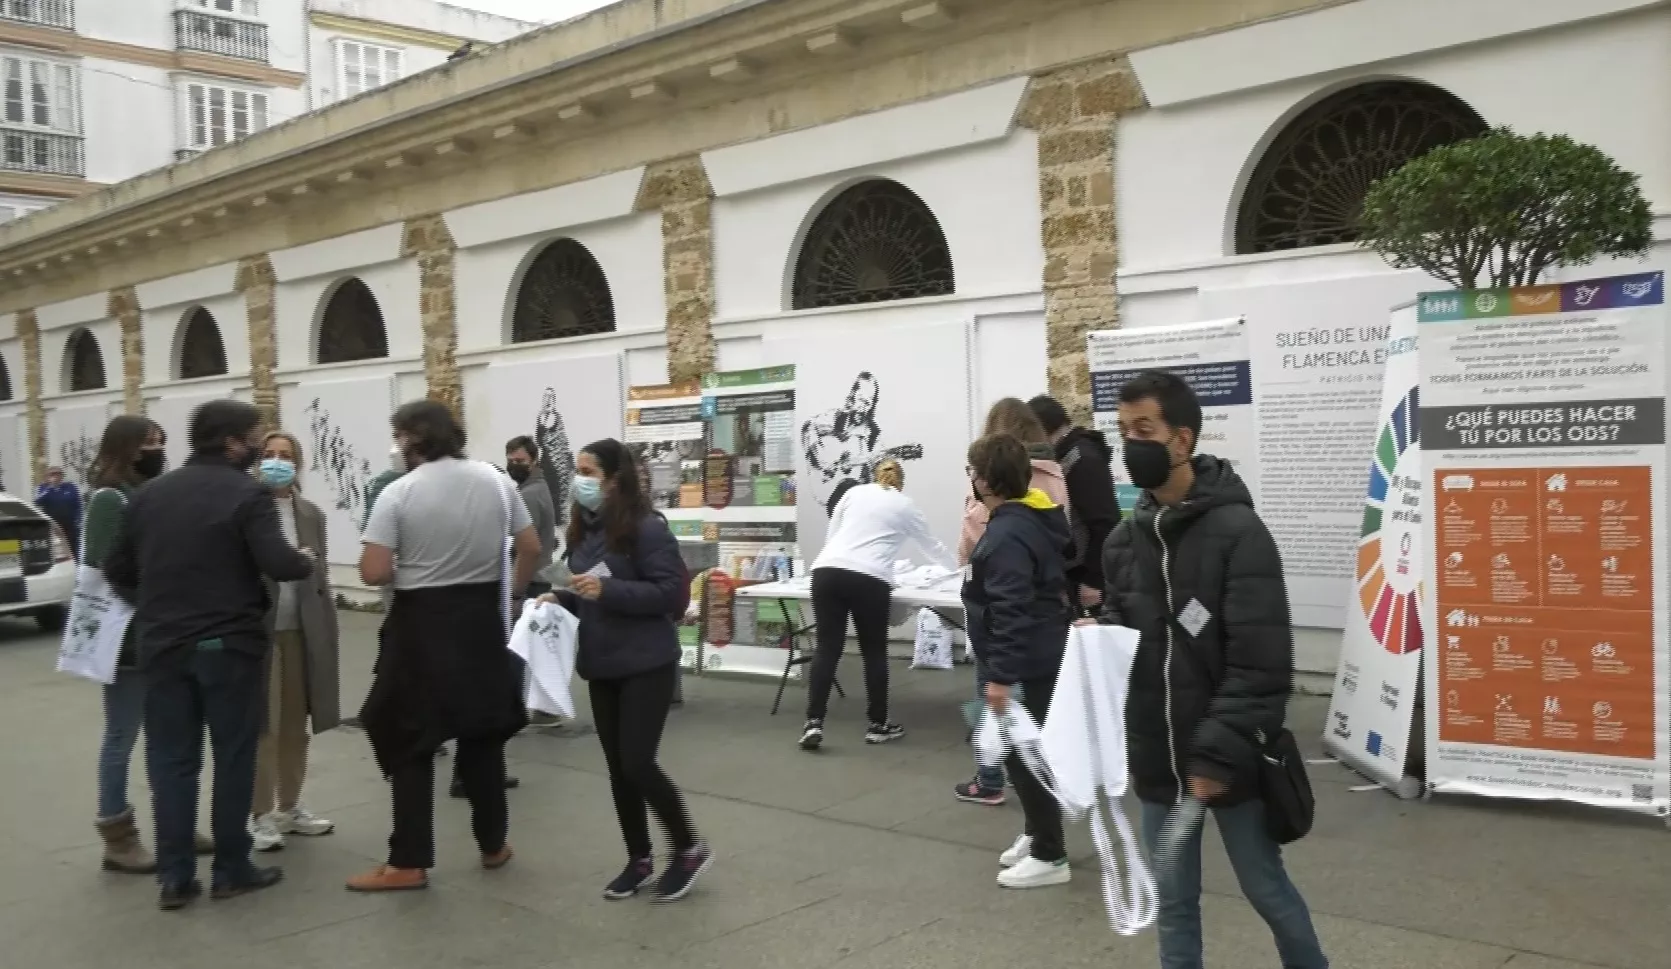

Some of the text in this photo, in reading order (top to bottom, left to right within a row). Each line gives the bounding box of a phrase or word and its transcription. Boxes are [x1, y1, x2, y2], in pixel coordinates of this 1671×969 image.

[1277, 324, 1392, 347] SUEÑO DE UNA
[1283, 349, 1370, 369] FLAMENCA
[1320, 374, 1364, 384] PATRICIO
[1465, 369, 1524, 383] FORMAMOS
[1527, 368, 1557, 379] PARTE
[1560, 367, 1573, 377] DE
[1576, 366, 1589, 376] LA
[1446, 405, 1637, 430] ¿QUÉ PUEDES HACER
[1460, 423, 1621, 445] TÚ POR LOS ODS?
